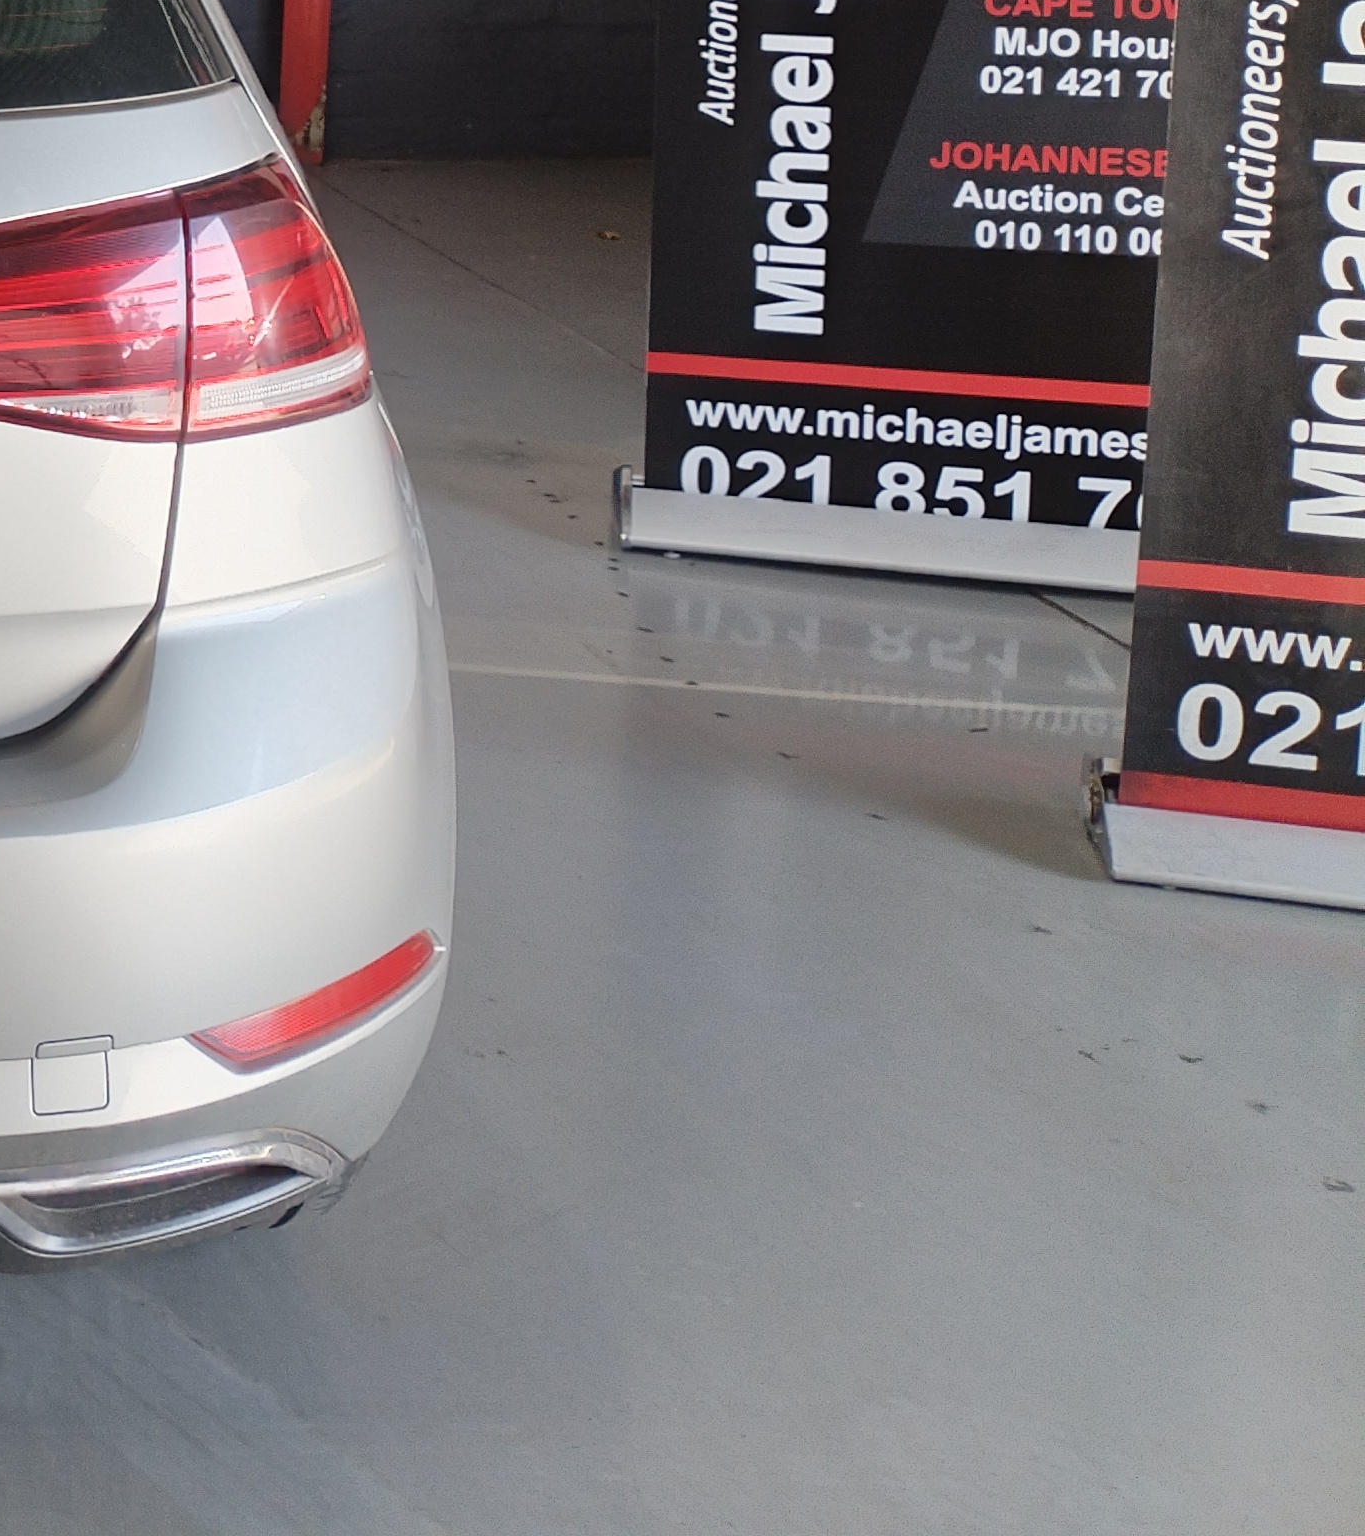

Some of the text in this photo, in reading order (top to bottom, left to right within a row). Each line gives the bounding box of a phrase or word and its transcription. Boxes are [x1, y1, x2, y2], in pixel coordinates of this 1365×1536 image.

[995, 27, 1175, 60] MJO Hou
[980, 66, 1173, 99] 021 421 70
[929, 141, 1168, 178] JOHANNES
[754, 33, 835, 336] Michael
[953, 180, 1102, 215] Auction
[975, 220, 1042, 251] 010
[1054, 224, 1117, 255] 110
[685, 398, 1148, 461] www.michaeljames
[680, 445, 832, 505] 021
[875, 461, 1032, 523] 851
